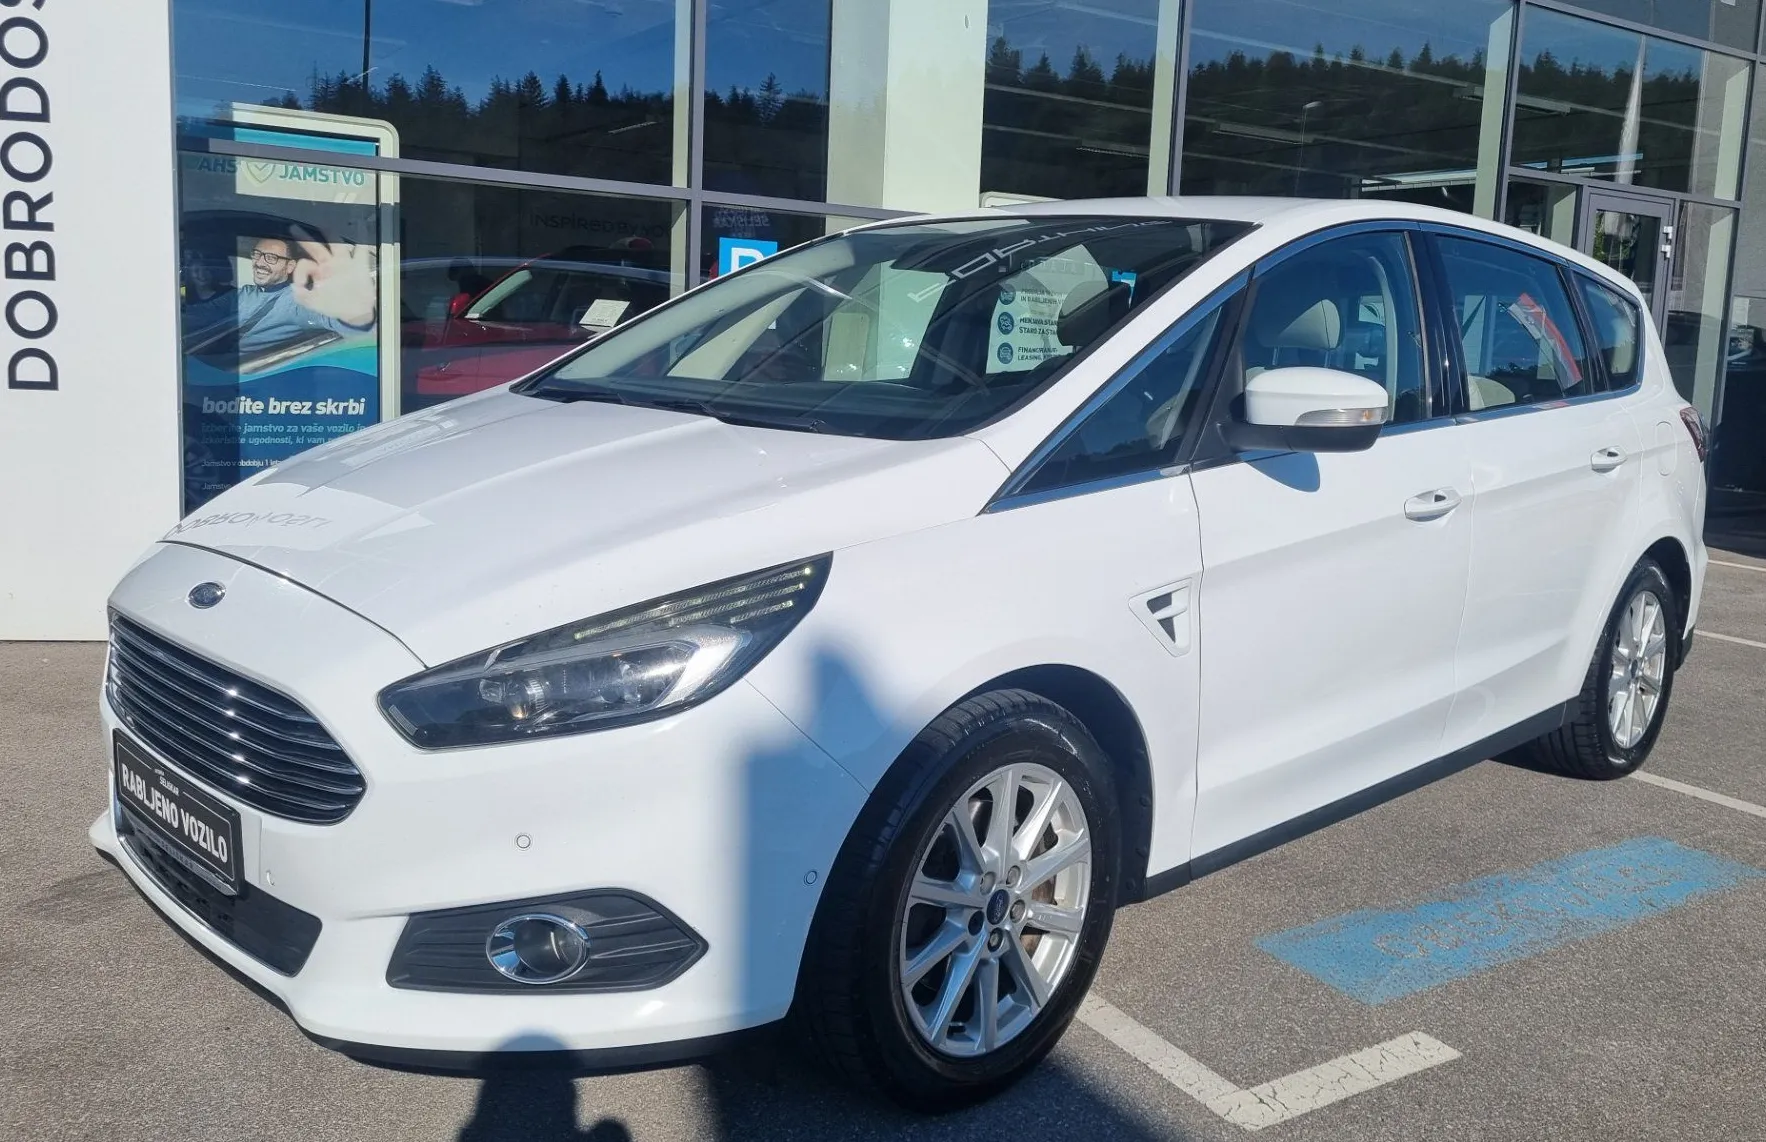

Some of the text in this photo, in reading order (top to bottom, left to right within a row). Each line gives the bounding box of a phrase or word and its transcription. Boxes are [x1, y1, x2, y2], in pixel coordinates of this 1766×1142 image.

[279, 164, 366, 187] JAMSTVO
[0, 0, 59, 391] DOBRODO
[202, 396, 366, 416] bodite brez skrbi
[242, 423, 285, 435] jamstvo
[287, 425, 298, 433] za
[301, 423, 324, 433] vaše
[121, 762, 179, 829] RABLJENO
[180, 807, 228, 863] VOZILO
